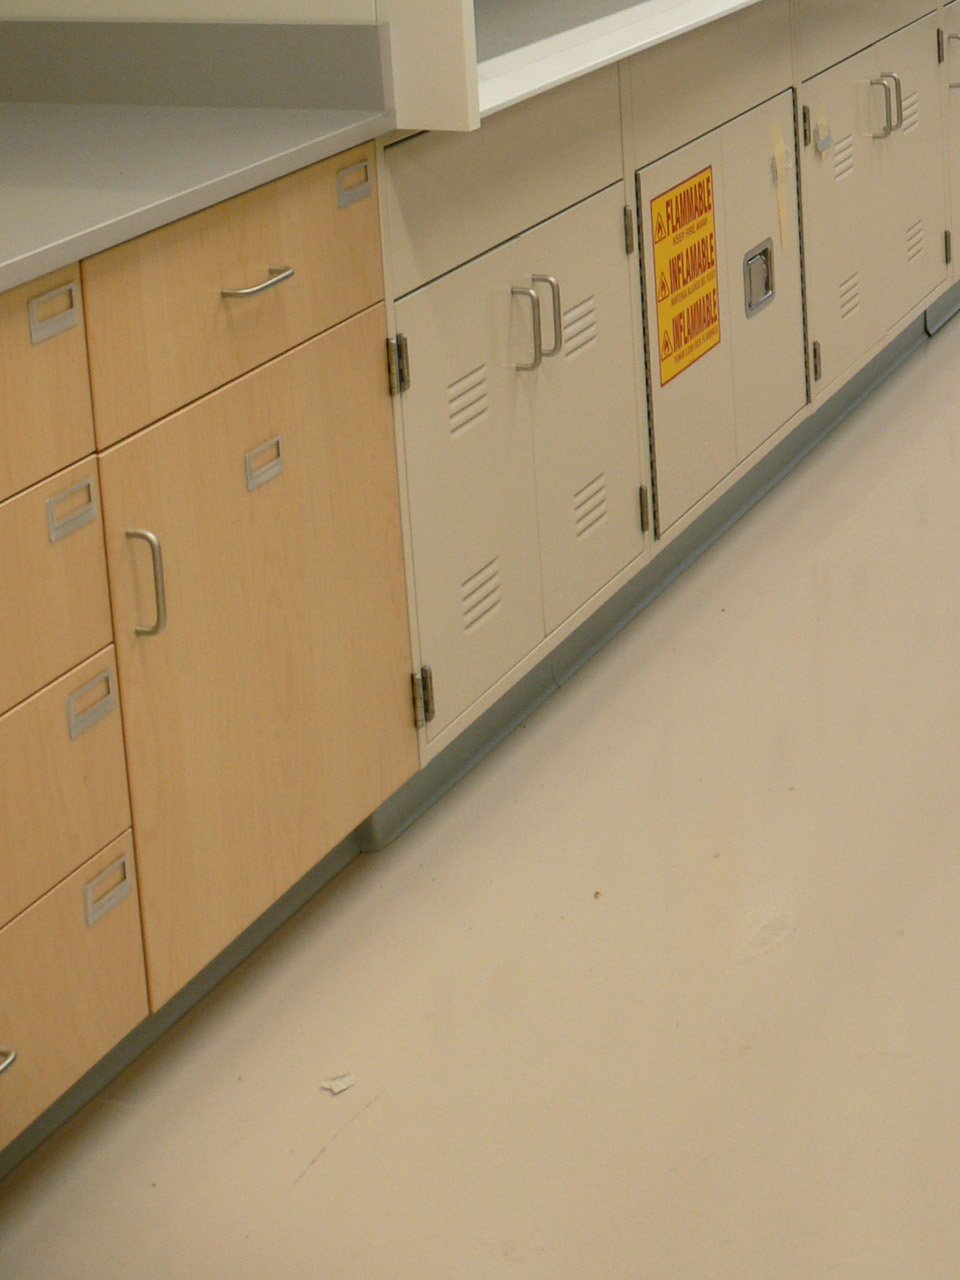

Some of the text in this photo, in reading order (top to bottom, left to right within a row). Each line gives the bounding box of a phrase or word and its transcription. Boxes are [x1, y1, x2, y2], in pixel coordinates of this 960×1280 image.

[665, 175, 712, 236] FLAMMABLE
[669, 232, 715, 296] INFLAMABLE
[672, 231, 685, 246] KEEP
[672, 288, 718, 353] INFLAMMABLE
